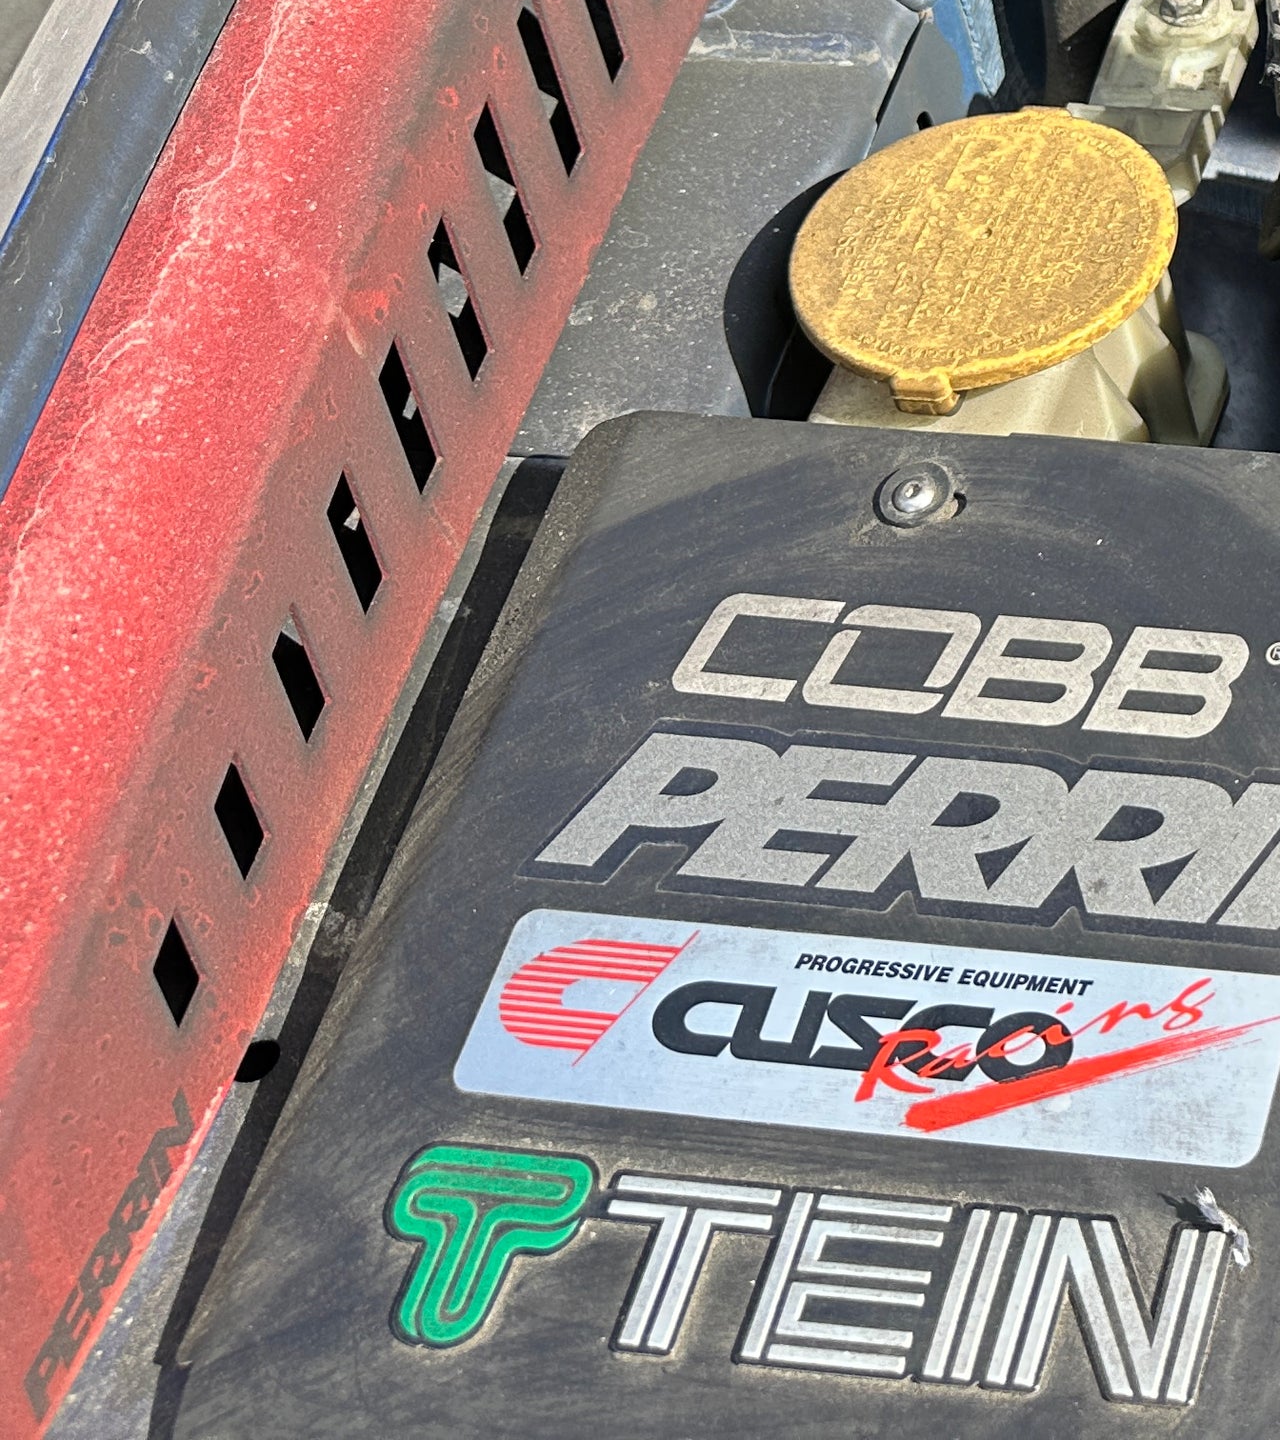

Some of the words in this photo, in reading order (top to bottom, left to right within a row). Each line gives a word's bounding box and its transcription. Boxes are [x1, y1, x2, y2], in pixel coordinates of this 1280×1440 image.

[671, 592, 1251, 739] COBB
[651, 979, 1074, 1083] CUSCO
[794, 953, 953, 984] PROGRESSIVE
[957, 969, 1094, 997] EQUIPMENT
[852, 977, 1216, 1103] Racing
[606, 1171, 1231, 1406] TEIN
